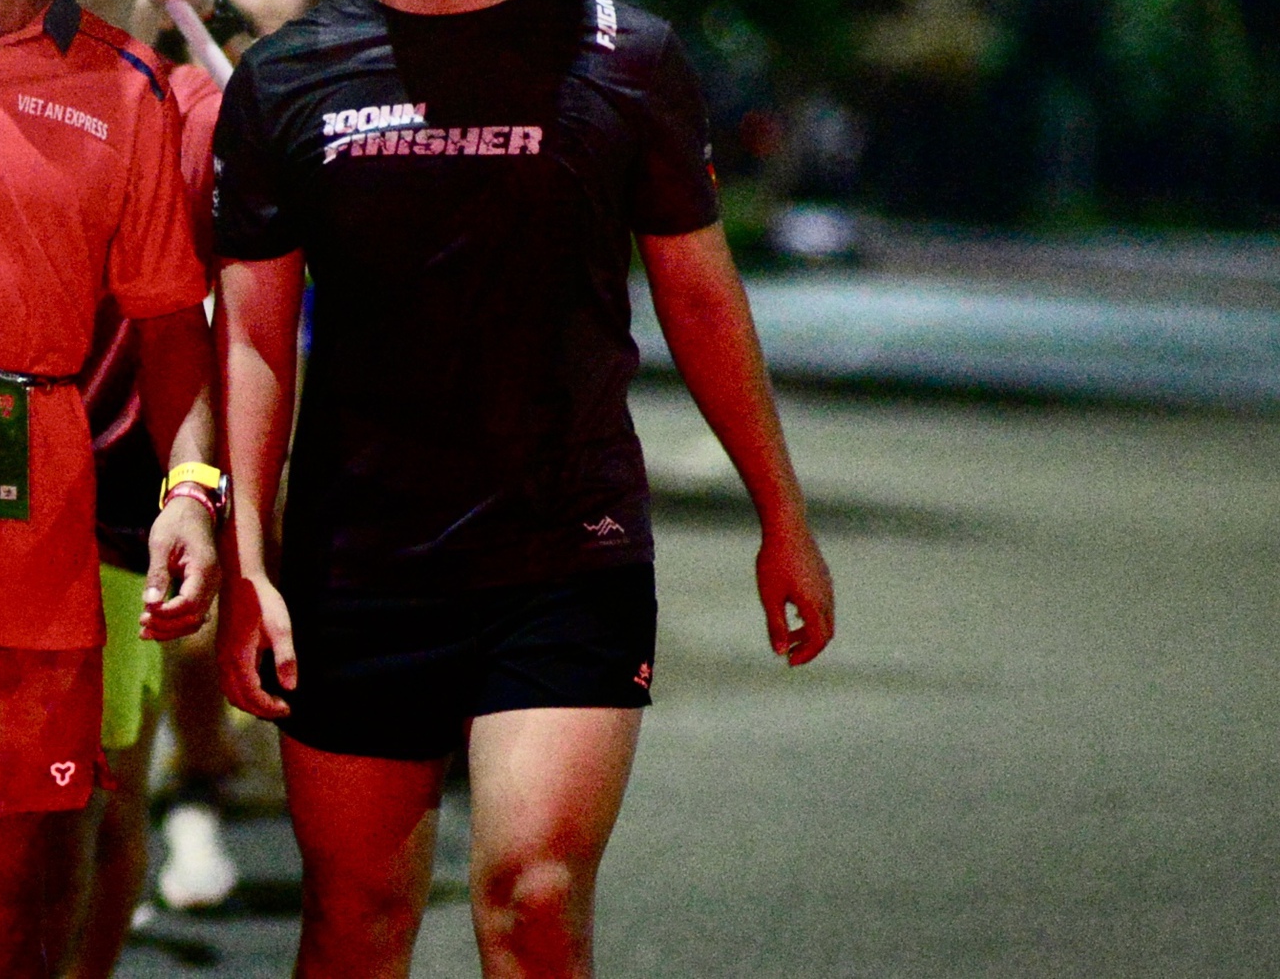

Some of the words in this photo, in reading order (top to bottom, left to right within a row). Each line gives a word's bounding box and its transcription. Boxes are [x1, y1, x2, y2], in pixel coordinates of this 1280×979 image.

[18, 93, 45, 117] VIET
[44, 102, 65, 122] AN
[64, 107, 109, 141] EXPRESS
[322, 102, 427, 137] 100KM
[322, 126, 544, 165] FINISHER
